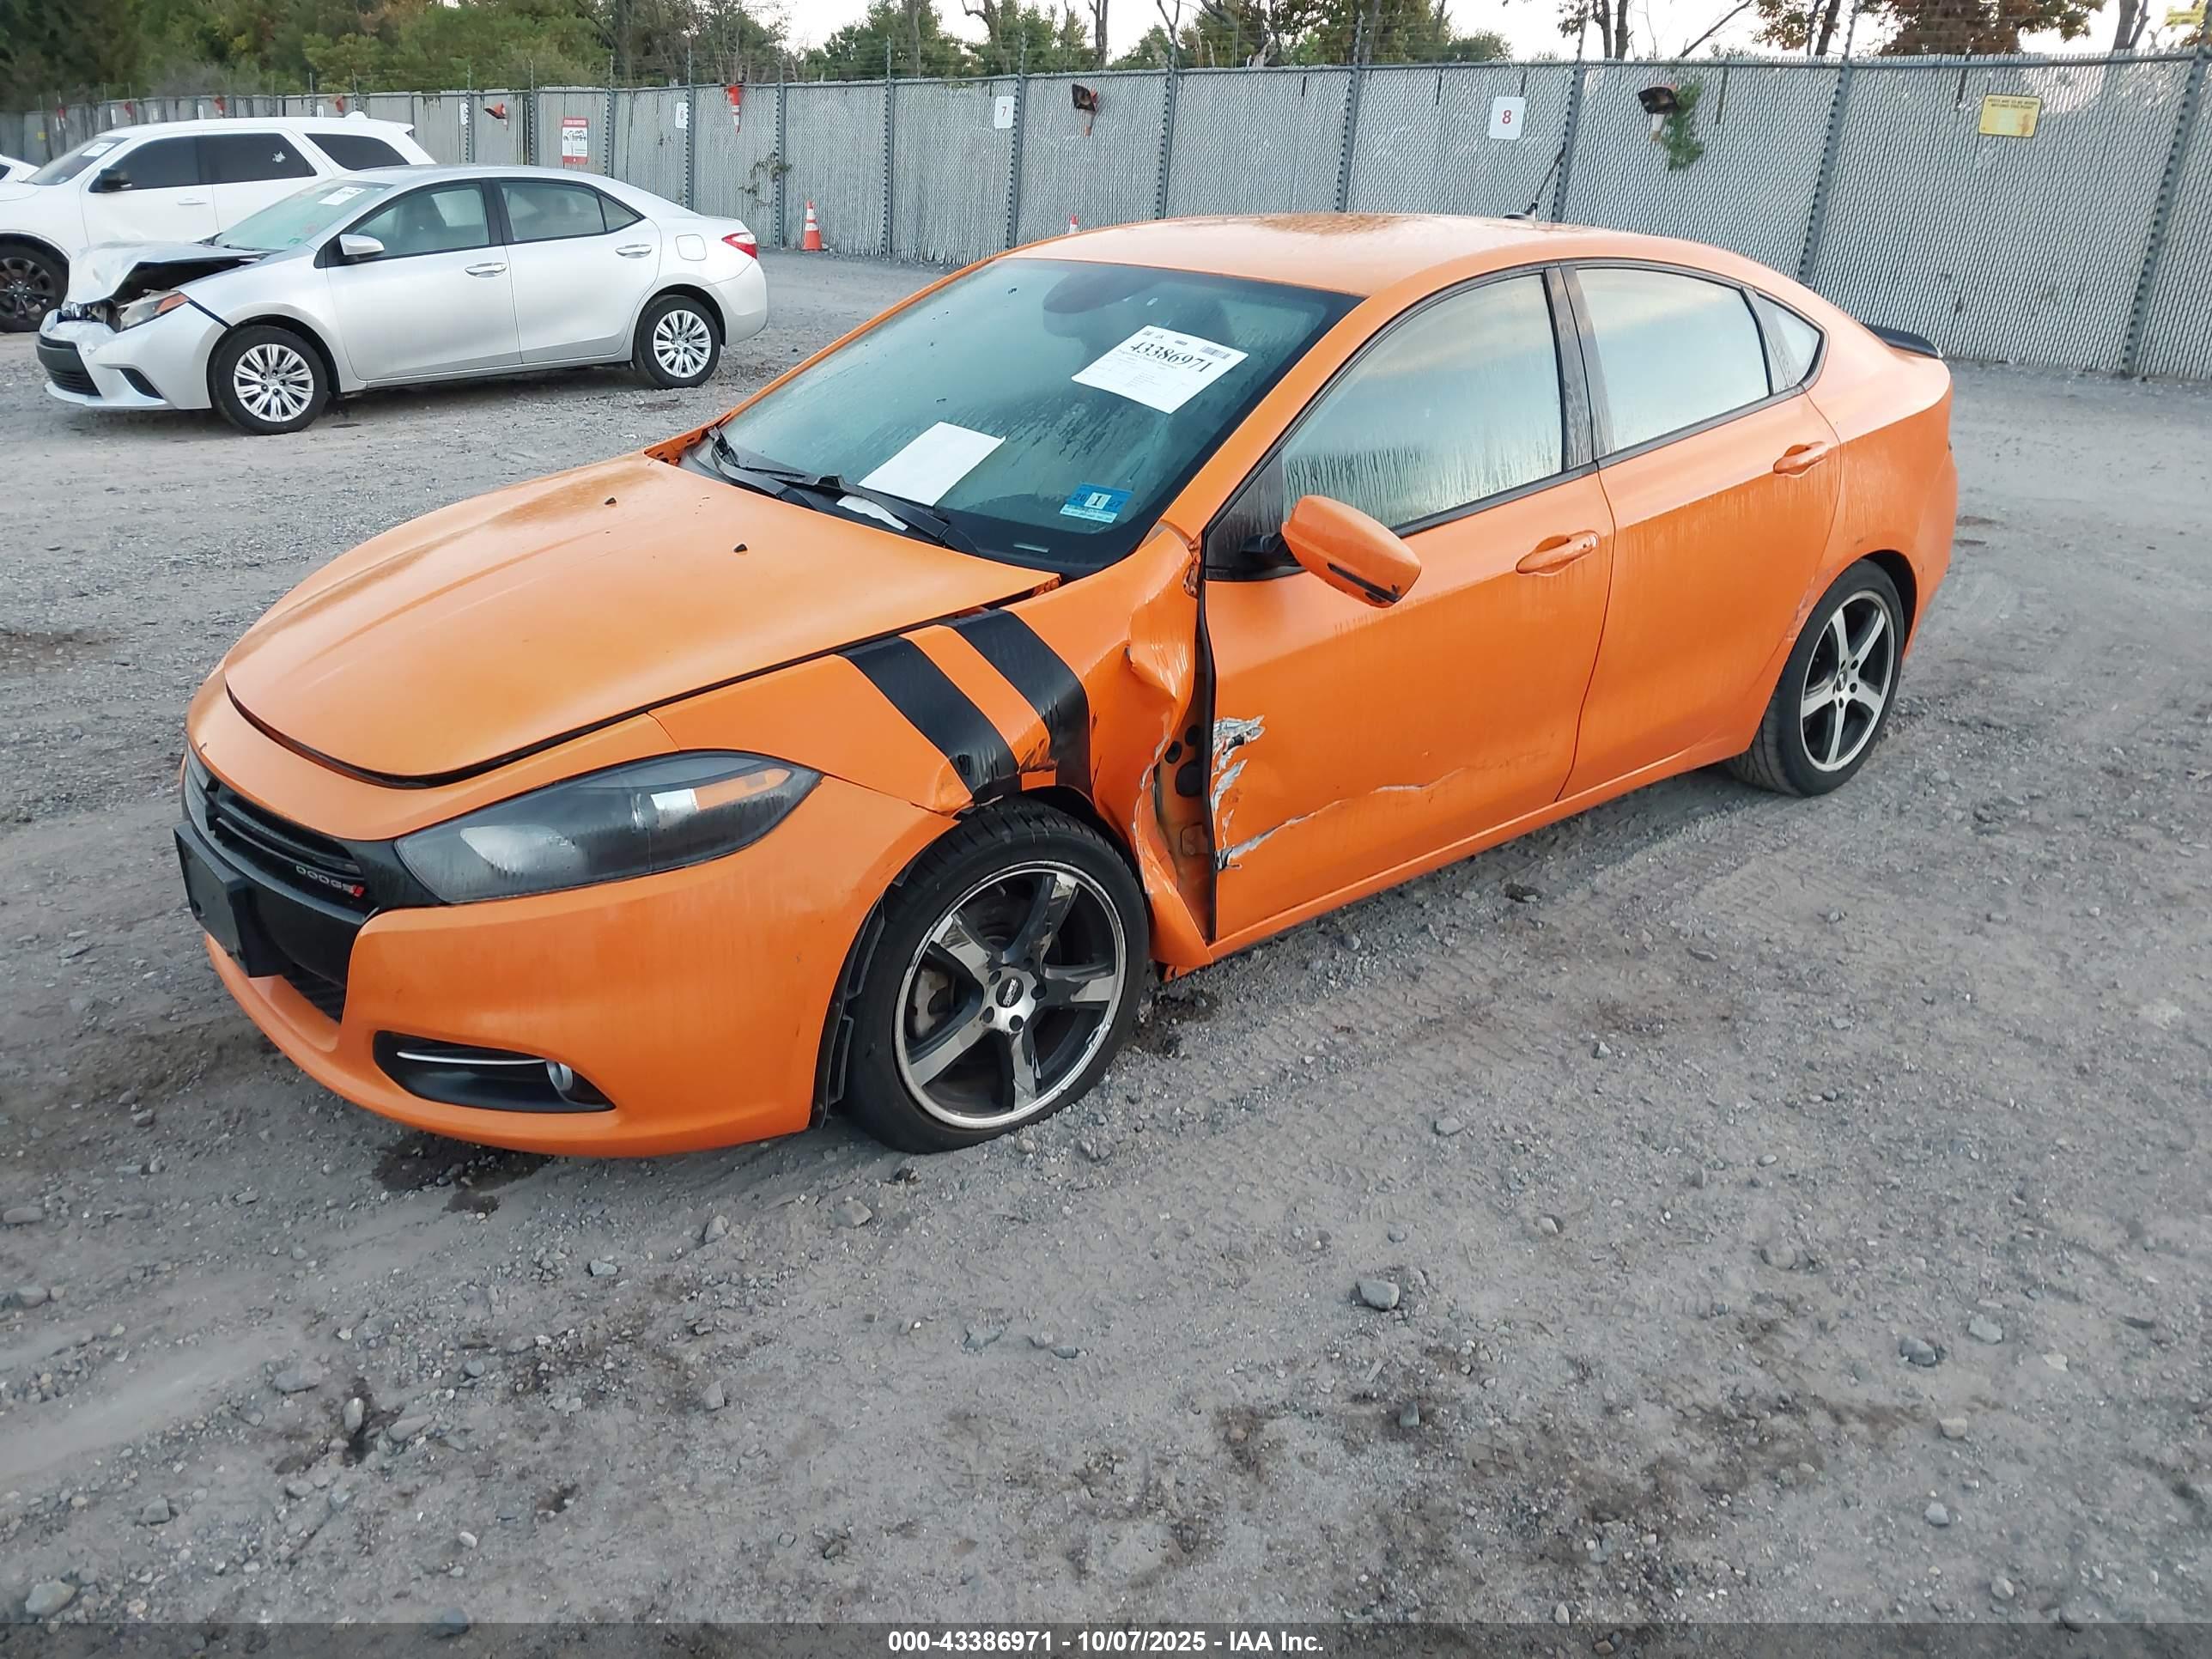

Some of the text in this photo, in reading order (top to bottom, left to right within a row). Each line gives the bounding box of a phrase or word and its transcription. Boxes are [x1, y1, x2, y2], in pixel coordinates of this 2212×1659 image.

[1002, 106, 1007, 118] 7
[1502, 109, 1512, 125] 8
[1130, 342, 1213, 373] 43386971
[1092, 495, 1103, 506] 1
[295, 865, 354, 895] DODGE
